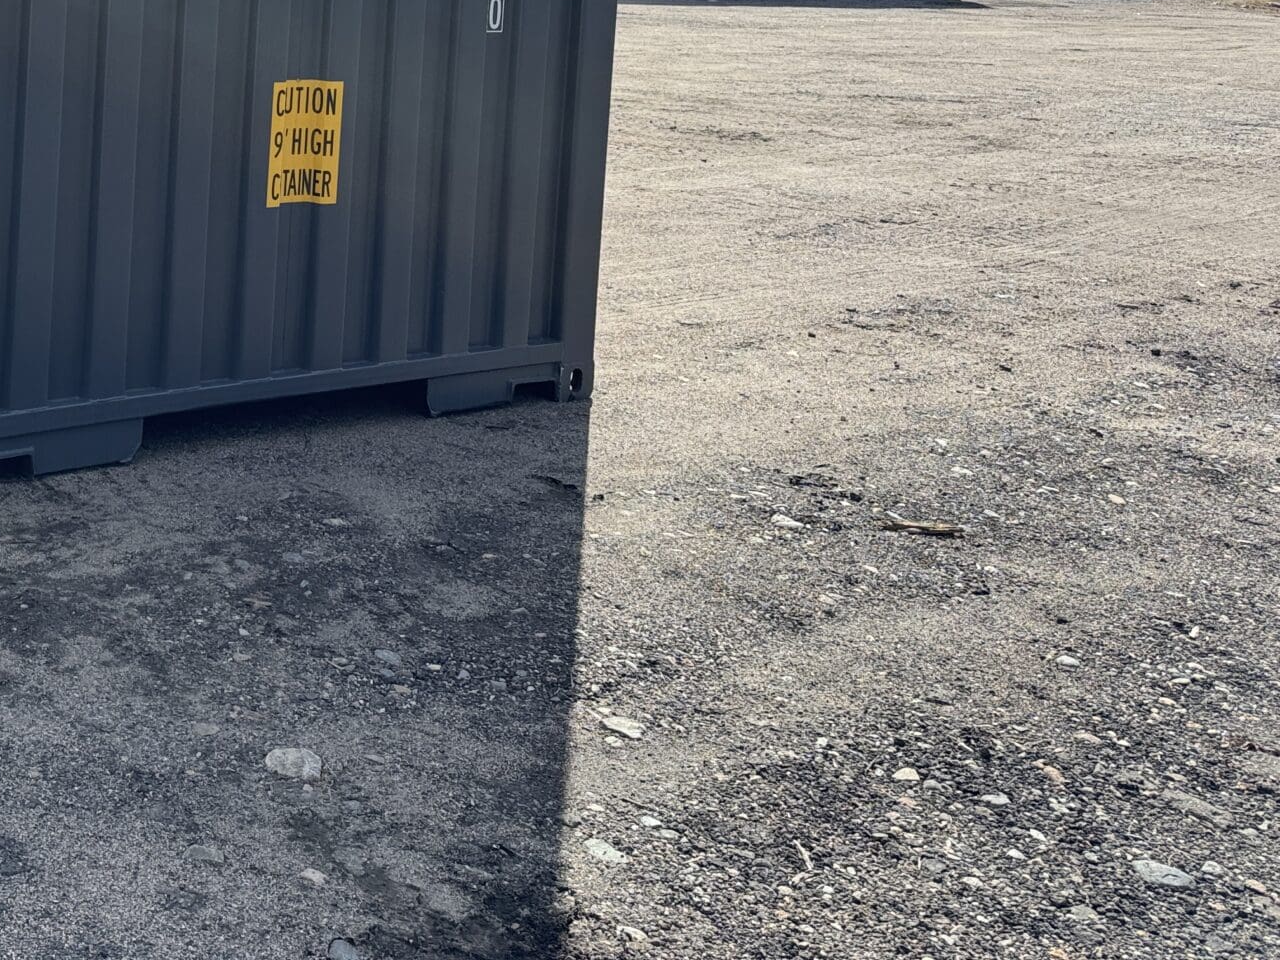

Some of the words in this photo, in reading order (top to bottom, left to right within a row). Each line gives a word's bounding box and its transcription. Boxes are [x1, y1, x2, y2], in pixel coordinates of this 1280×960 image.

[276, 86, 337, 117] CUTION
[274, 128, 288, 158] 9'
[291, 128, 334, 157] HIGH
